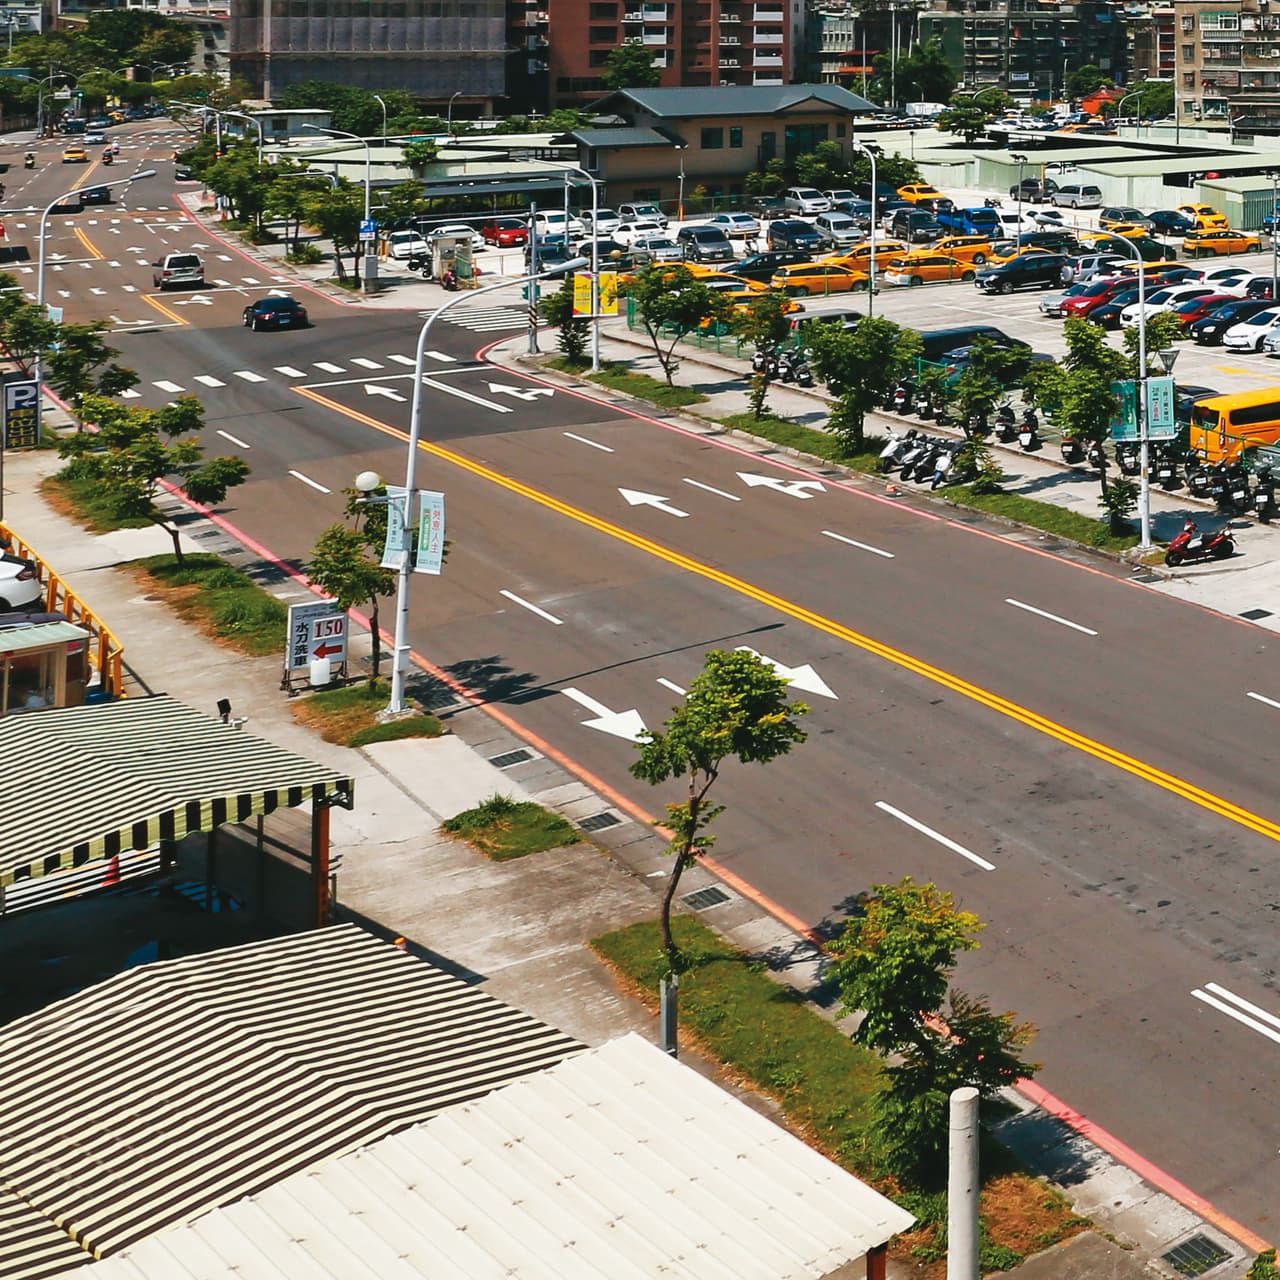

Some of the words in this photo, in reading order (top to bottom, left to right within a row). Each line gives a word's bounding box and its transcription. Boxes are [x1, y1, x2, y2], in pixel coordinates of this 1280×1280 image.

[7, 385, 37, 410] P
[314, 618, 343, 638] 150
[293, 622, 309, 666] 水刀洗車
